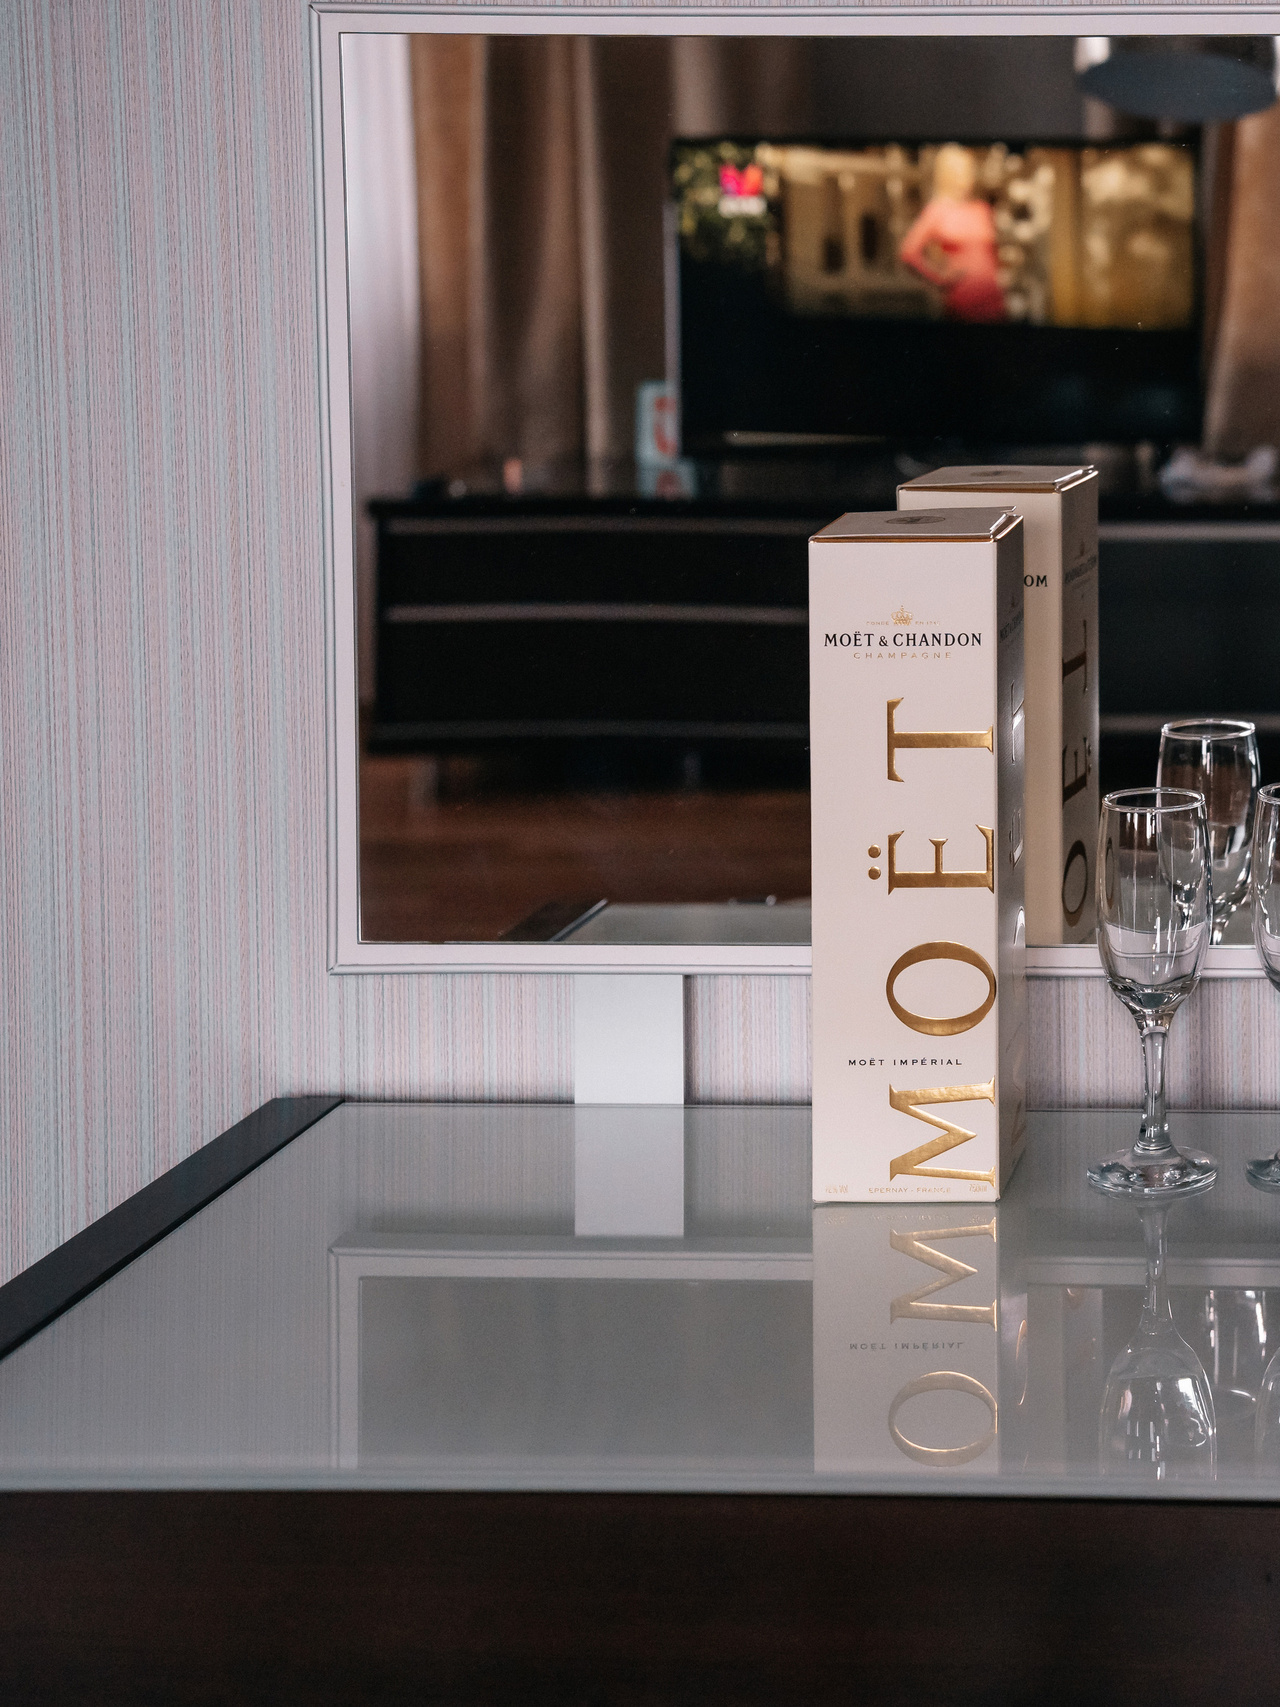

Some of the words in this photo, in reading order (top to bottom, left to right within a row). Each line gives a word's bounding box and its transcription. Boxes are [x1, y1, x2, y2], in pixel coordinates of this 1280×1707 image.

[823, 631, 875, 647] MOËT
[878, 635, 889, 647] &
[892, 632, 982, 647] CHANDON
[853, 652, 952, 660] CHAMPAGNE
[867, 697, 997, 1188] MOËT
[848, 1056, 886, 1067] MOËT
[893, 1056, 963, 1067] IMPÉRIAL
